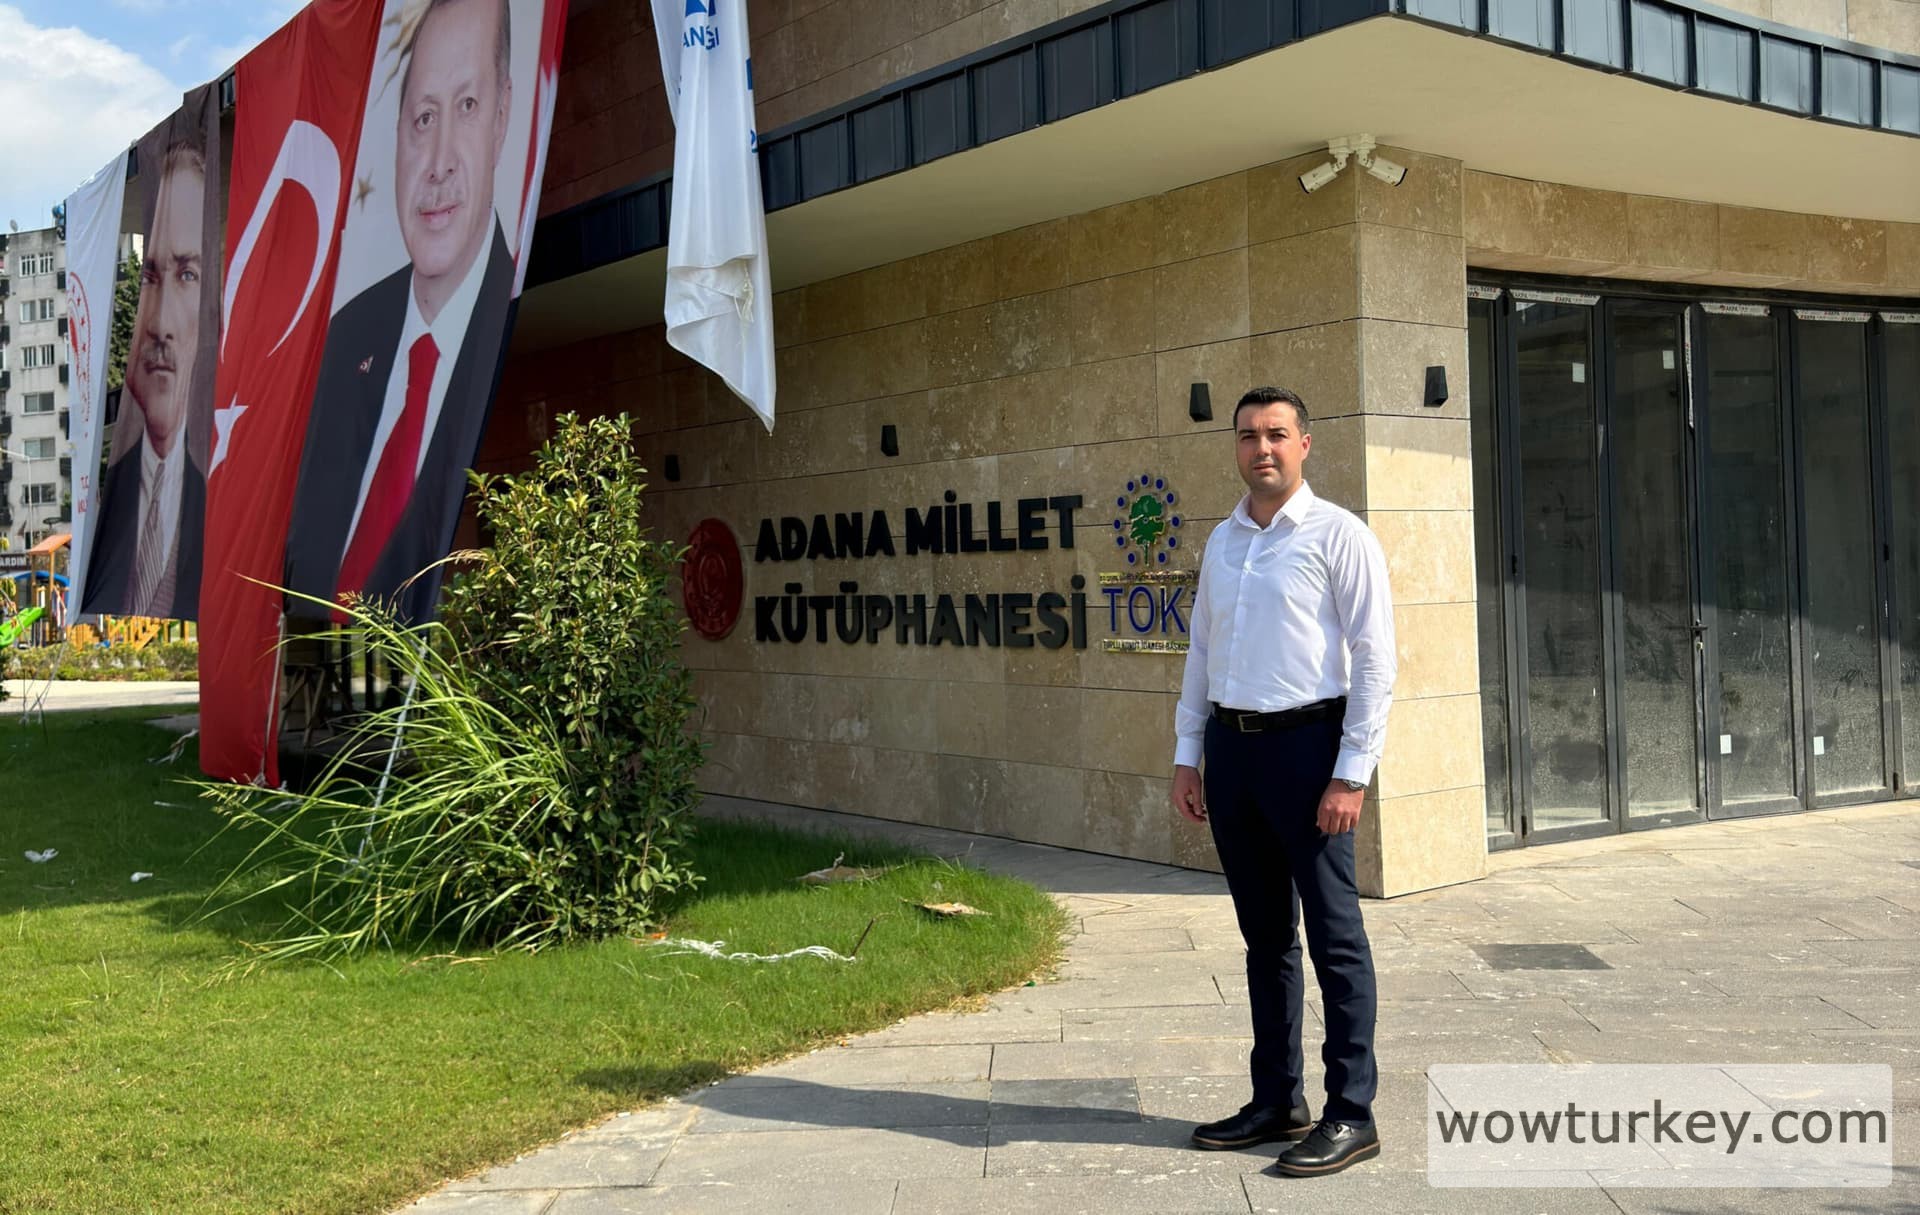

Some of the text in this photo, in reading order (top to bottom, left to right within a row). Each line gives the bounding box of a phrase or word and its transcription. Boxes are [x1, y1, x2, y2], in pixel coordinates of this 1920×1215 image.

[755, 489, 1083, 563] ADANA MİLLET
[755, 574, 1087, 649] KÜTÜPHANESİ
[1101, 585, 1197, 634] TOK
